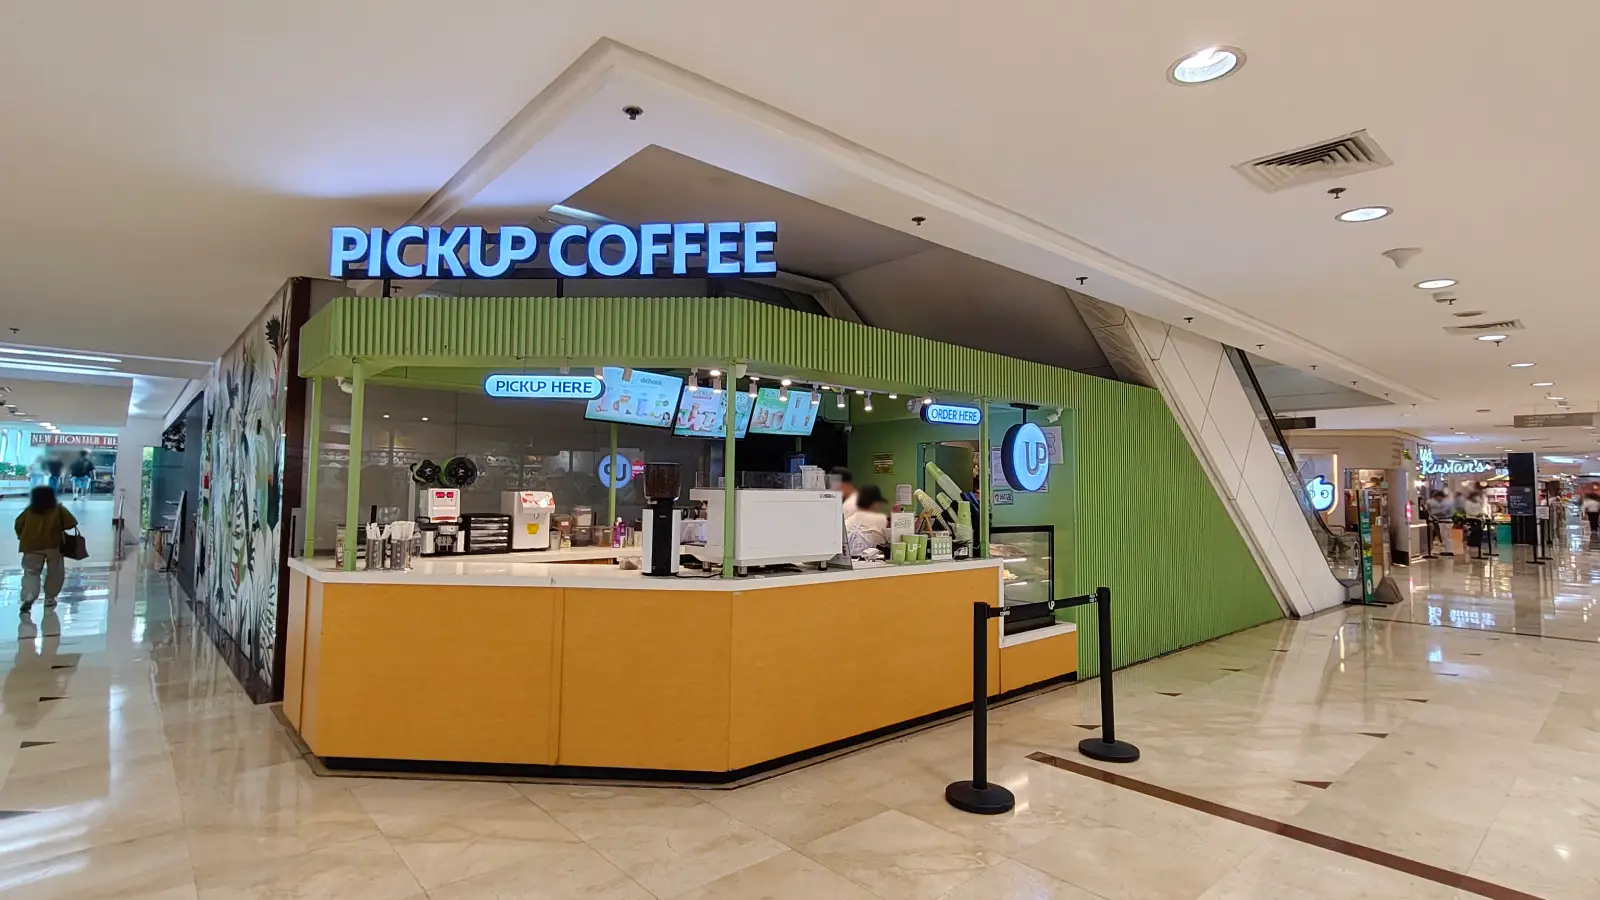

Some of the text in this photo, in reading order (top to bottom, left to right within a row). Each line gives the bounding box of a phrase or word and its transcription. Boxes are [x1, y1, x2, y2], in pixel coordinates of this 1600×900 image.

[330, 221, 777, 278] PICKUP COFFEE
[496, 380, 592, 393] PICKUP HERE
[931, 408, 978, 422] ORDER HERE
[32, 434, 51, 444] NEW
[54, 435, 100, 445] FRONTIER
[1023, 441, 1047, 476] UP
